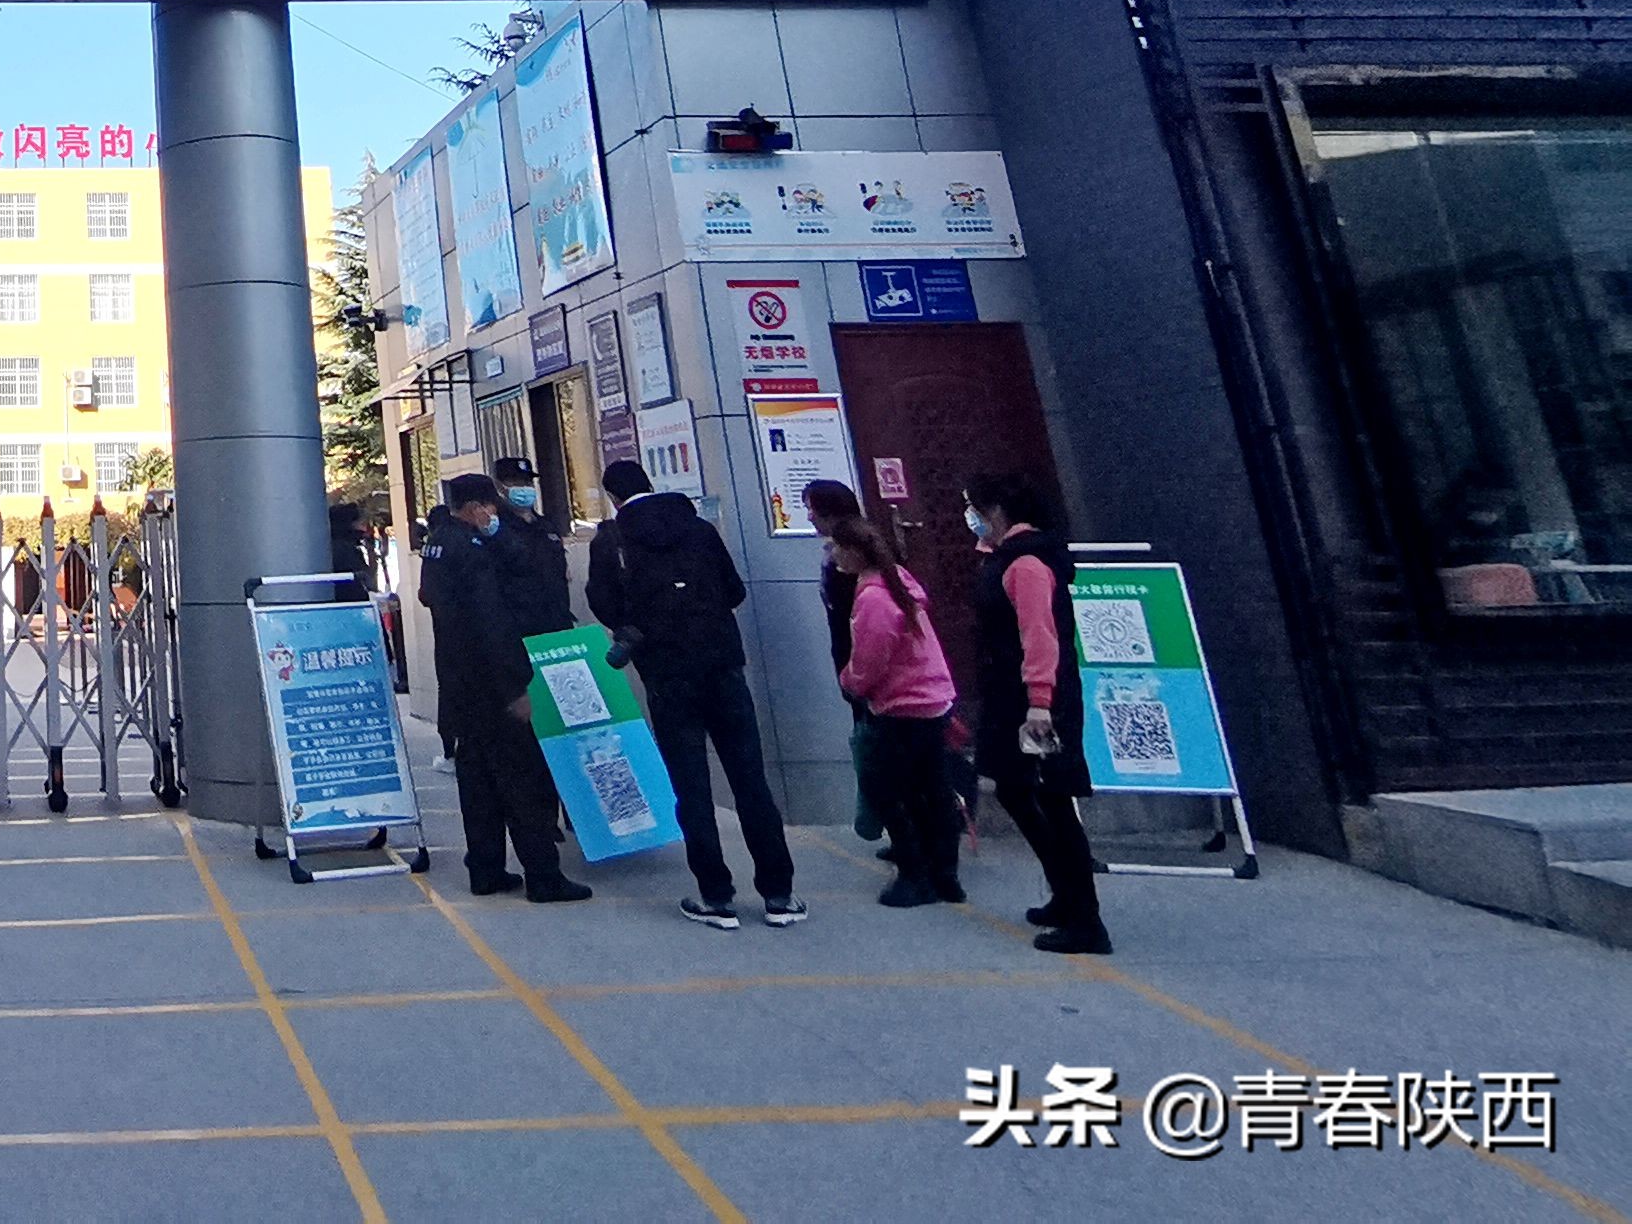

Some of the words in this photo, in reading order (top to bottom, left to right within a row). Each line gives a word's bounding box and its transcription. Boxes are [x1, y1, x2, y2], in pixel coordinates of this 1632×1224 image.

[744, 345, 807, 360] 无烟学校
[302, 646, 373, 673] 温馨提示
